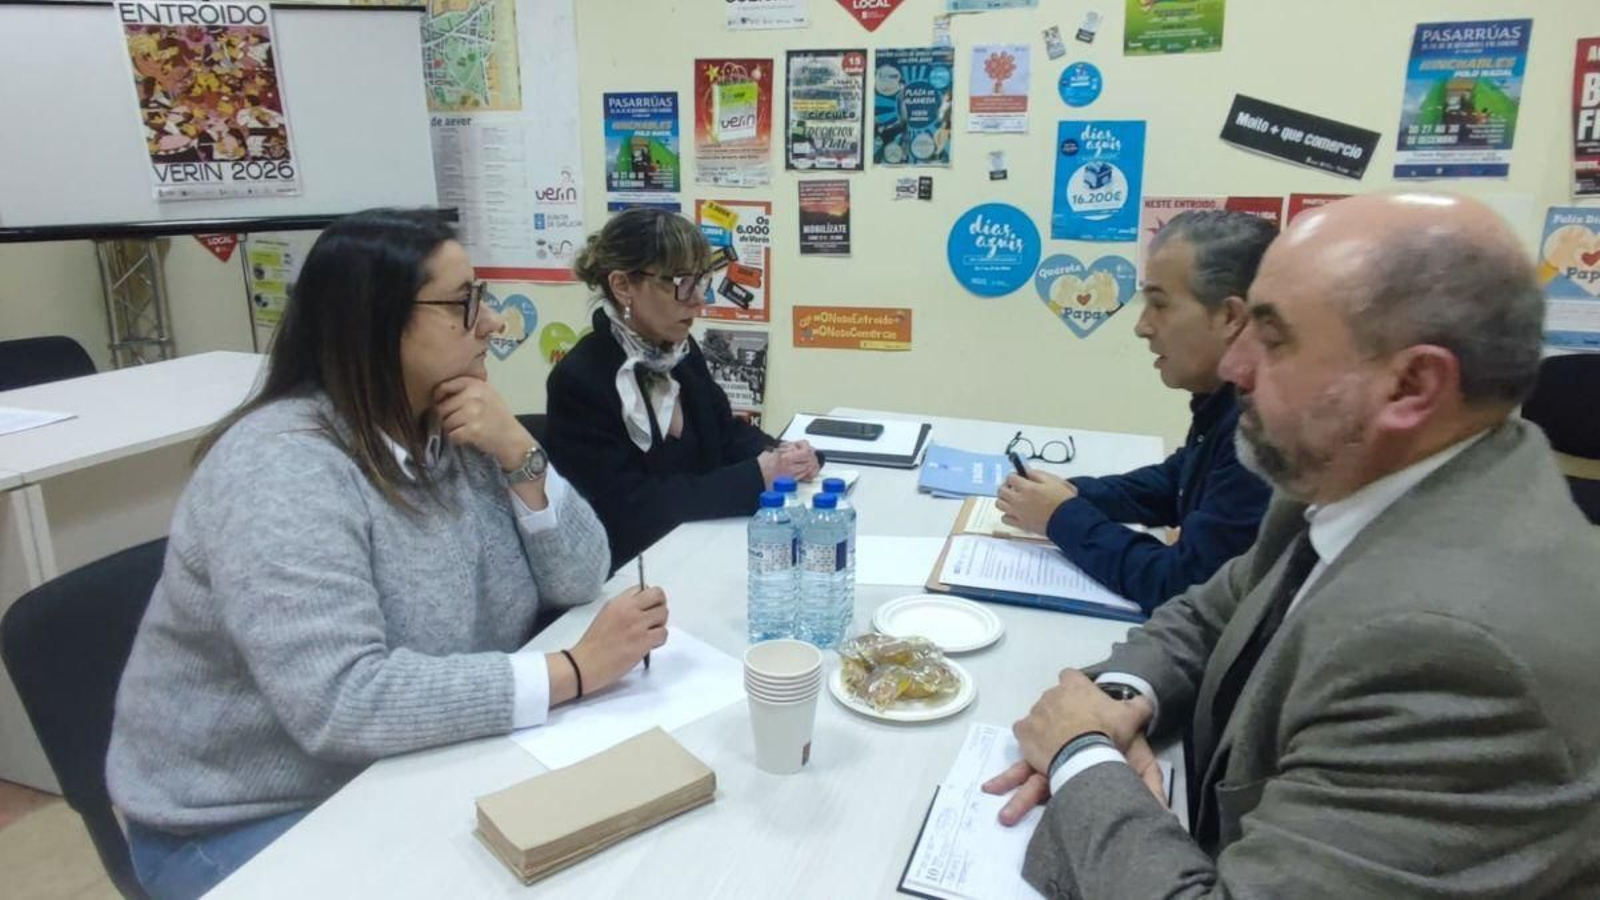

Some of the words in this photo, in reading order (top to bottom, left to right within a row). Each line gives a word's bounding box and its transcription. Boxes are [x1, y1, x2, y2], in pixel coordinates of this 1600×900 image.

[119, 3, 267, 25] ENTROIDO
[1421, 24, 1521, 42] PASARRÚAS
[1236, 111, 1269, 132] Moito
[1281, 126, 1304, 142] que
[1304, 133, 1363, 159] comercio
[231, 161, 295, 180] 2026
[1073, 191, 1122, 205] 16.200€
[1144, 200, 1173, 208] NESTE
[1174, 200, 1216, 208] ENTROIDO
[736, 225, 770, 235] 6.000
